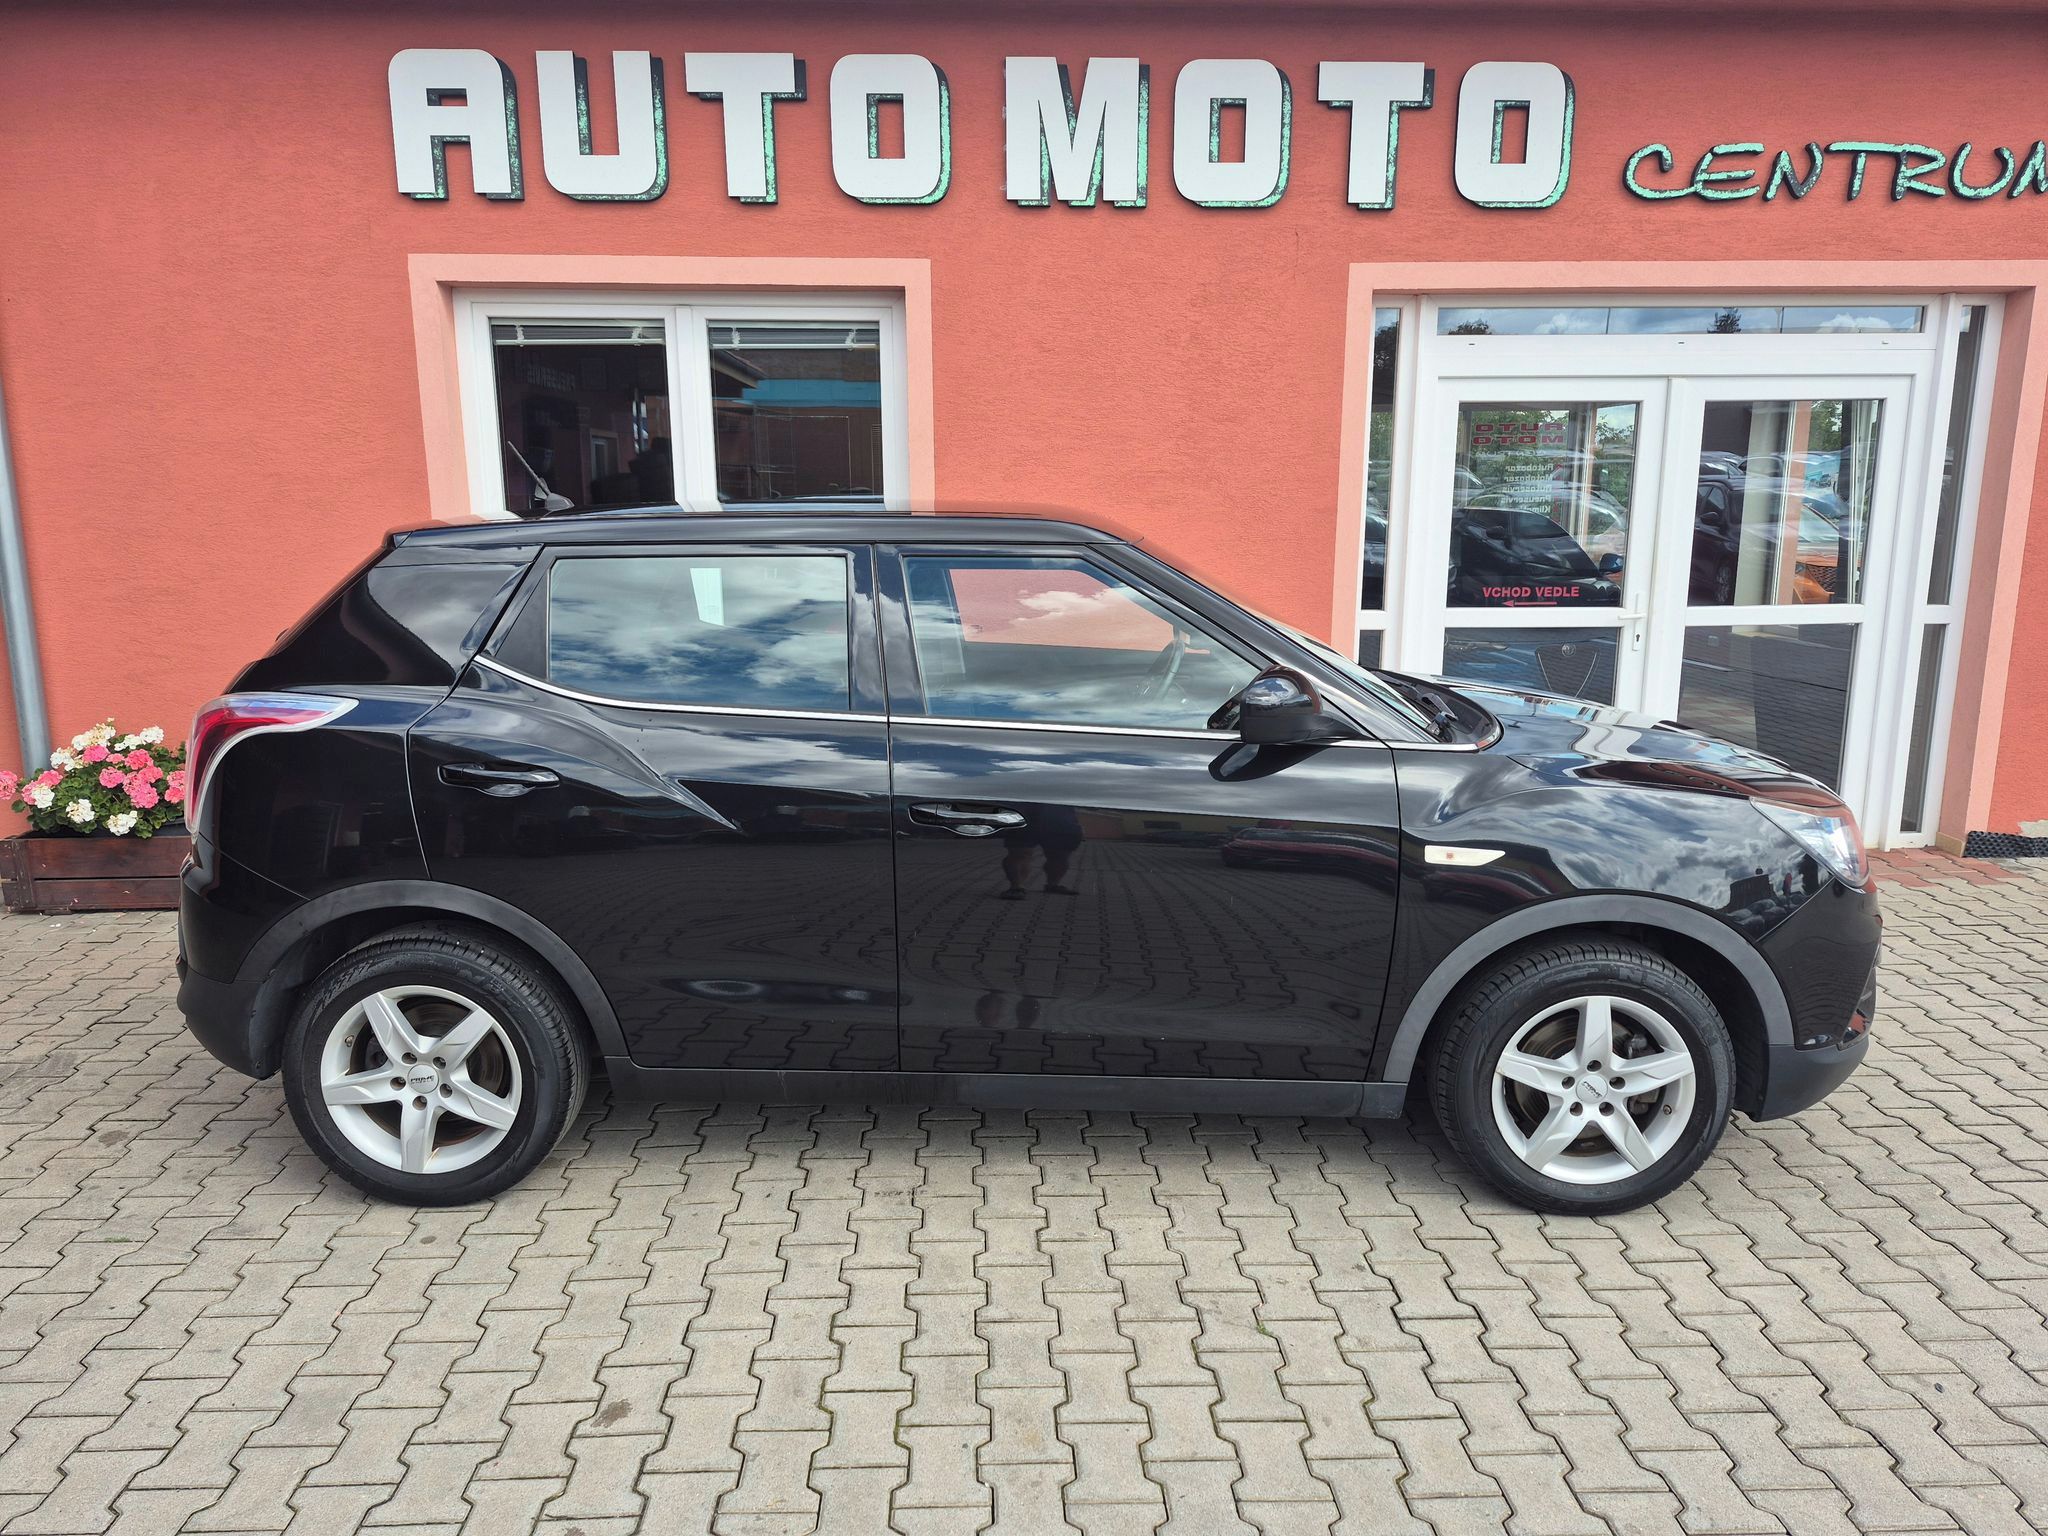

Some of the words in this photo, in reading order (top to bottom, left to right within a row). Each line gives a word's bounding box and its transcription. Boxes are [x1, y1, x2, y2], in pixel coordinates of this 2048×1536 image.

[388, 48, 951, 205] AUTO
[1004, 56, 1575, 210] MOTO
[1482, 588, 1531, 597] VCHOD
[1535, 587, 1580, 597] VEDLE
